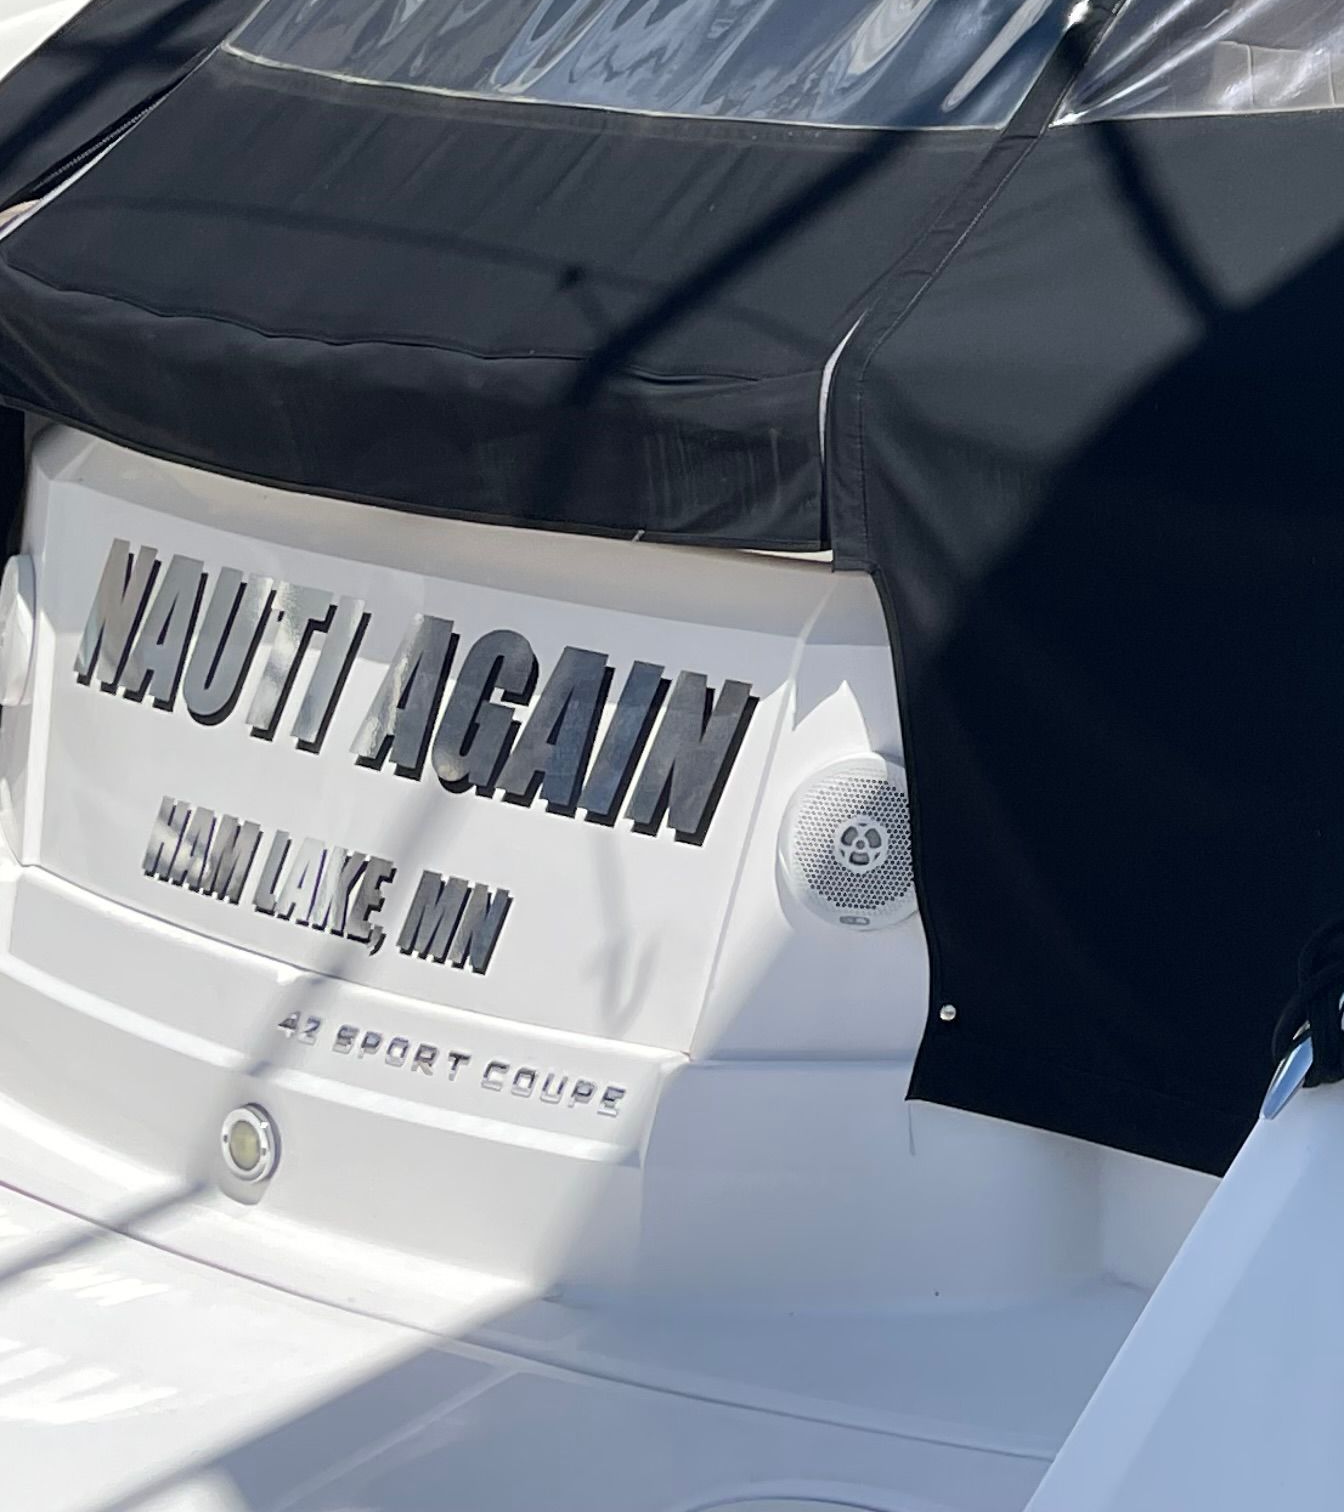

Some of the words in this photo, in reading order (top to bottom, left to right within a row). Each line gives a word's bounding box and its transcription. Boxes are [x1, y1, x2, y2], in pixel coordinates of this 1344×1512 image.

[74, 538, 372, 755] NAUTI
[350, 613, 760, 847] AGAIN
[142, 795, 264, 906] HAM
[252, 829, 397, 957] LAKE,
[396, 870, 514, 976] MN
[277, 1010, 322, 1045] 42
[331, 1023, 471, 1082] SPORT
[481, 1059, 627, 1117] COUPE
